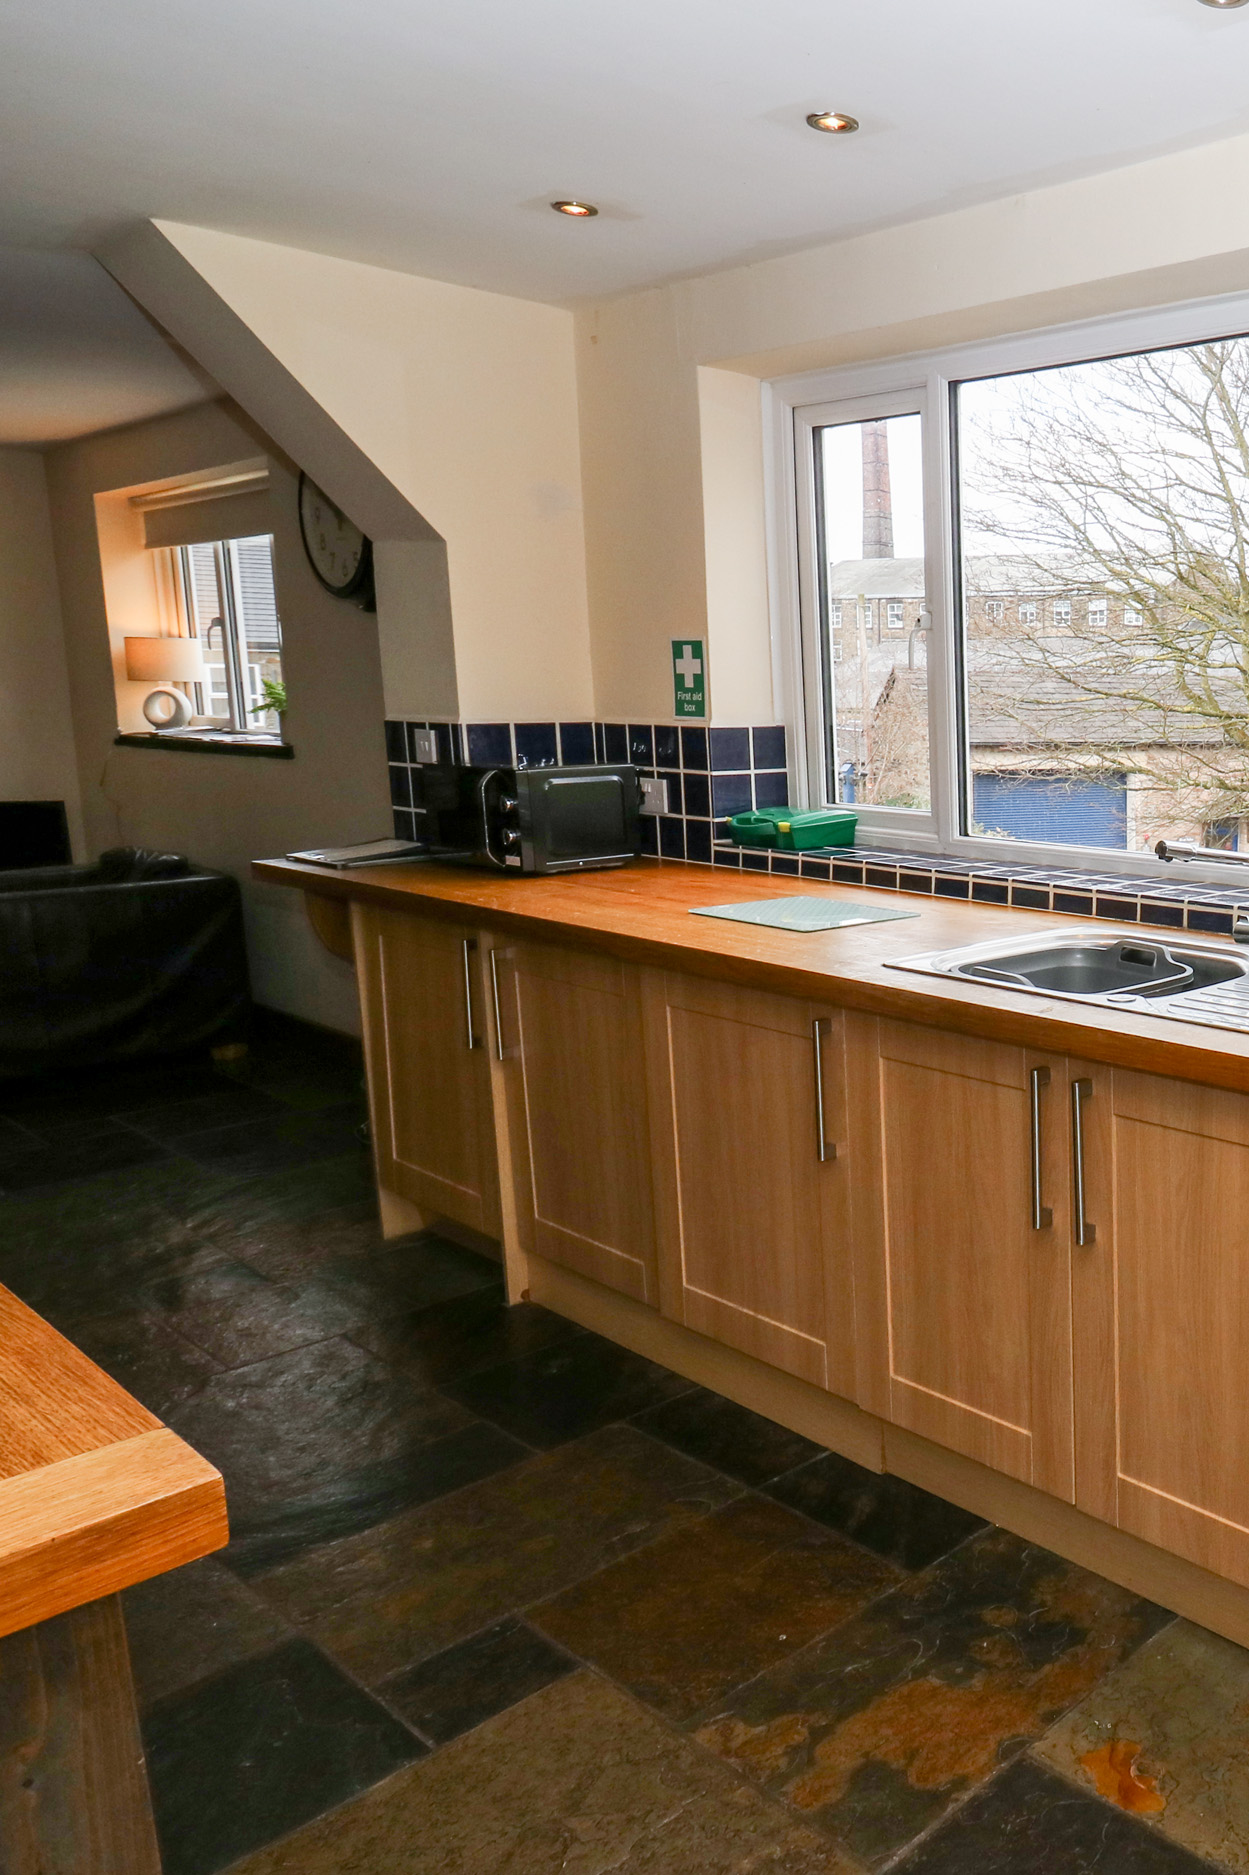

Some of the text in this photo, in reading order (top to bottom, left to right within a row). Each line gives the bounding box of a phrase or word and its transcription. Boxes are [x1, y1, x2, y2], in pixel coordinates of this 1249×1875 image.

[677, 691, 703, 701] First aid
[684, 702, 696, 712] box
